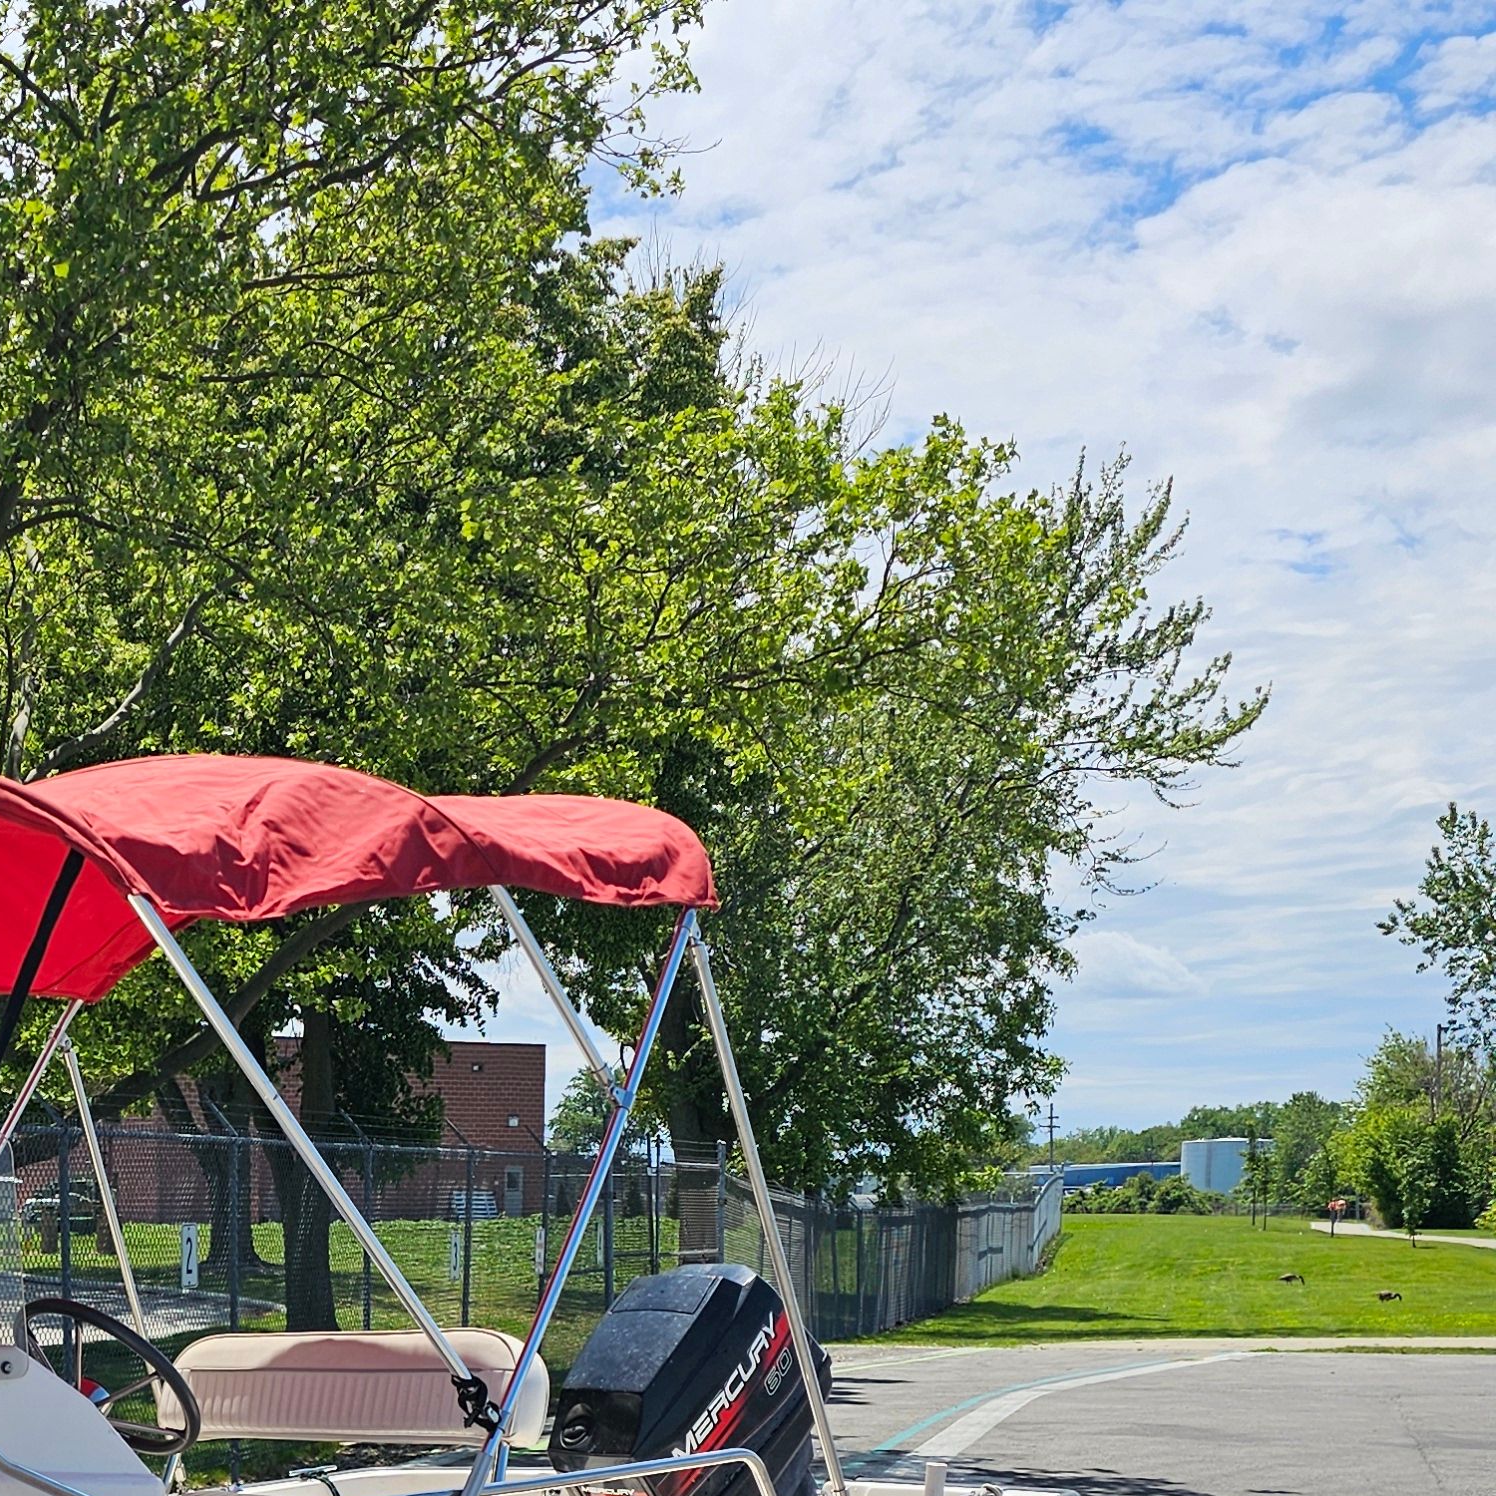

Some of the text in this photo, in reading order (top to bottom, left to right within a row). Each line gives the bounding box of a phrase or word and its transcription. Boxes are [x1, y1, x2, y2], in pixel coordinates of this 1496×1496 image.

[186, 1237, 193, 1274] 2
[671, 1310, 776, 1458] MERCURY
[581, 1485, 636, 1496] MERCURY
